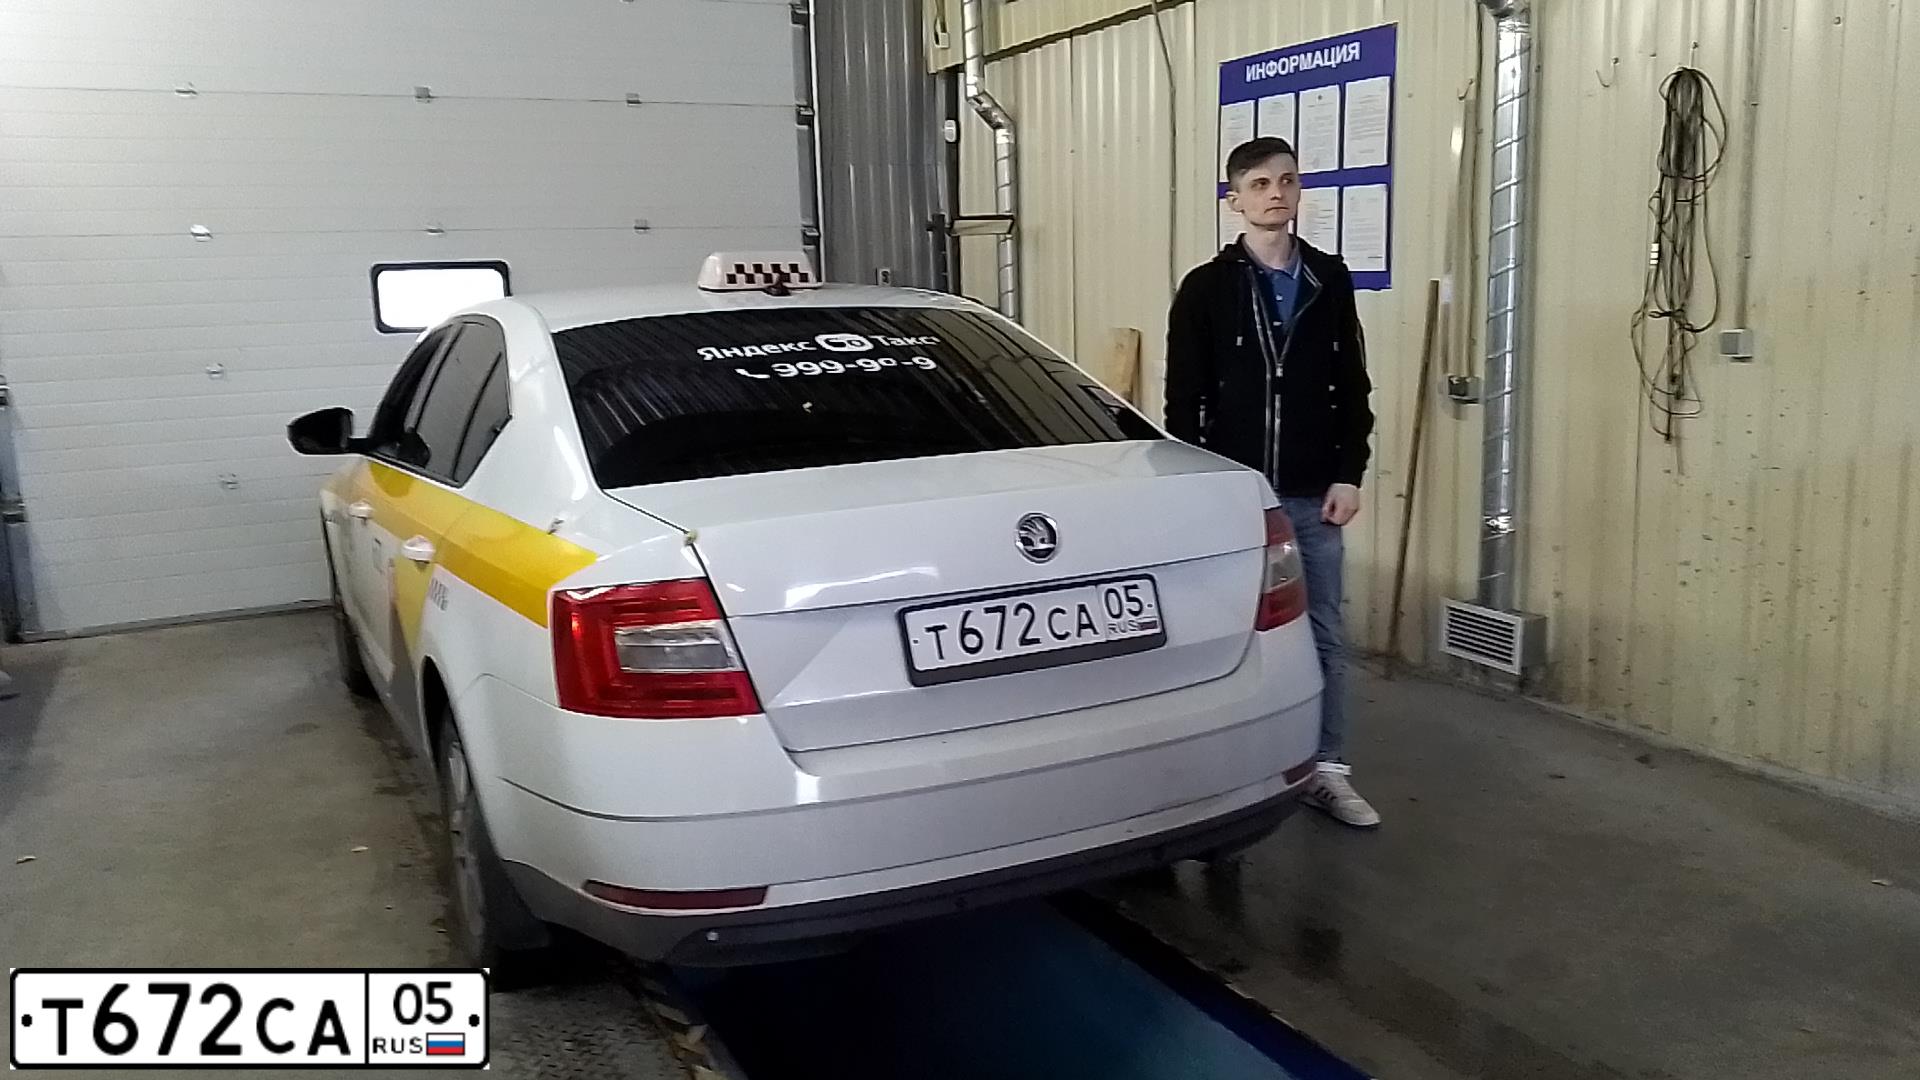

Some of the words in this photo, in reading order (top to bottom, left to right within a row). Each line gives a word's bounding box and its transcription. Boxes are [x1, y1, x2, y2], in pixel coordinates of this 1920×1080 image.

[1245, 41, 1360, 82] ИНФОРМАЦИЯ
[697, 341, 817, 361] Яндекс
[925, 602, 1099, 660] Т672СА
[1104, 584, 1143, 619] 05
[1107, 620, 1138, 634] RUS
